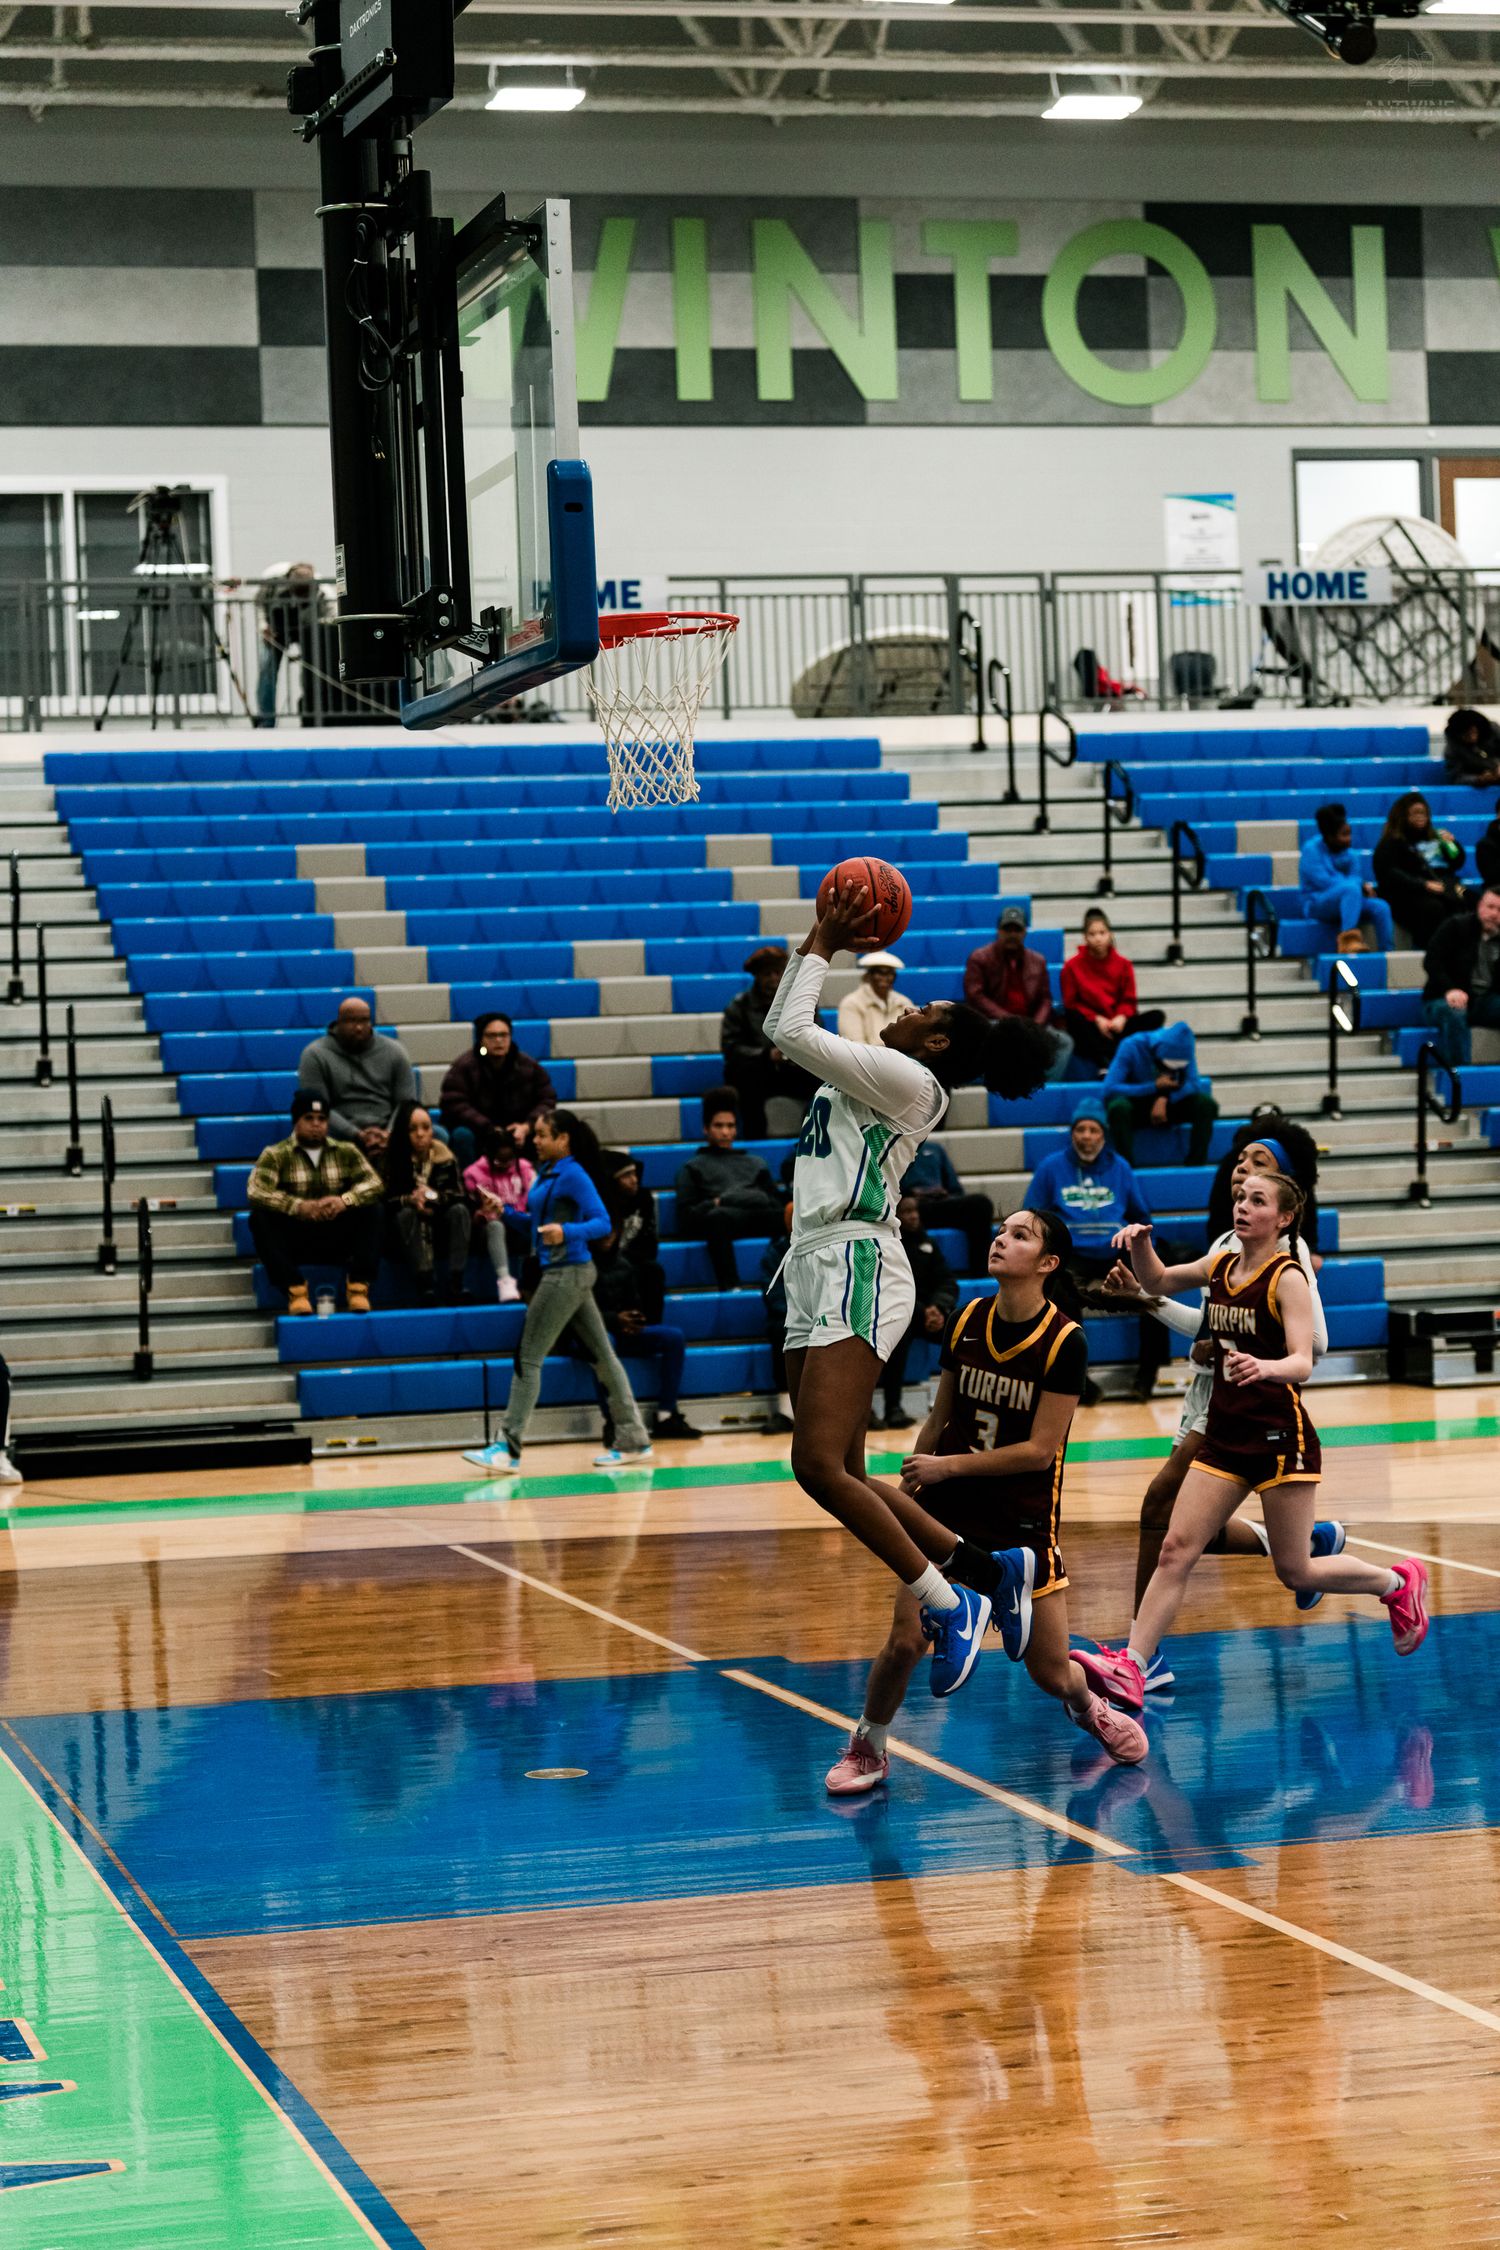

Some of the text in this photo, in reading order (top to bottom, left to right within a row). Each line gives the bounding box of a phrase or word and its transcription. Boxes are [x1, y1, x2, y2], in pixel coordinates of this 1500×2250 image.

[1267, 572, 1368, 600] HOME
[958, 1364, 1035, 1412] TURPIN
[969, 1409, 999, 1453] 3
